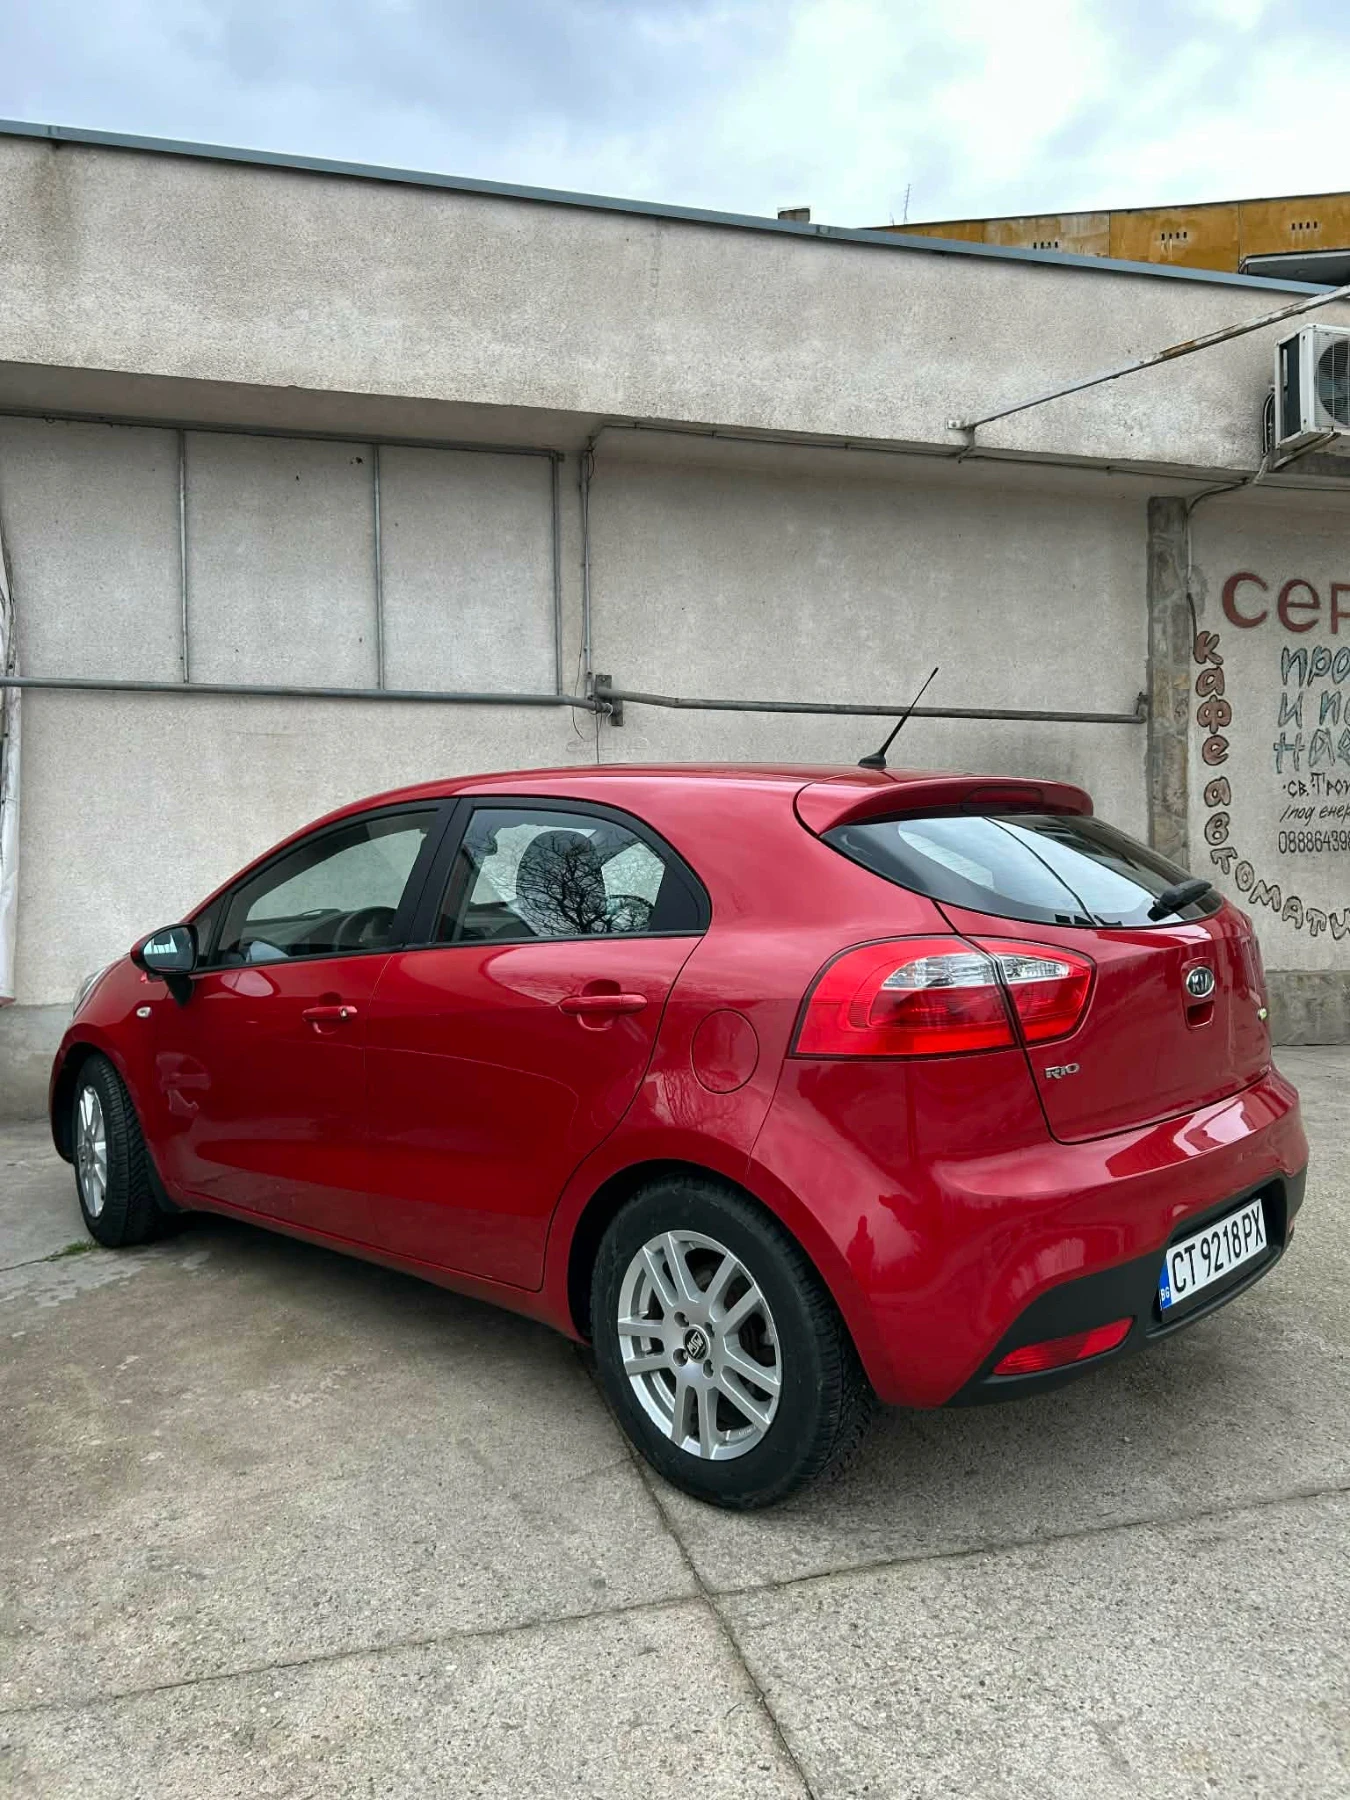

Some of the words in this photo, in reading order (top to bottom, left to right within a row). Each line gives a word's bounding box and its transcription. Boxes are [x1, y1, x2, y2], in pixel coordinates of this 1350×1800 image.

[1193, 630, 1232, 766] кафе
[1278, 830, 1350, 854] 08886439
[1045, 1062, 1080, 1079] RIO
